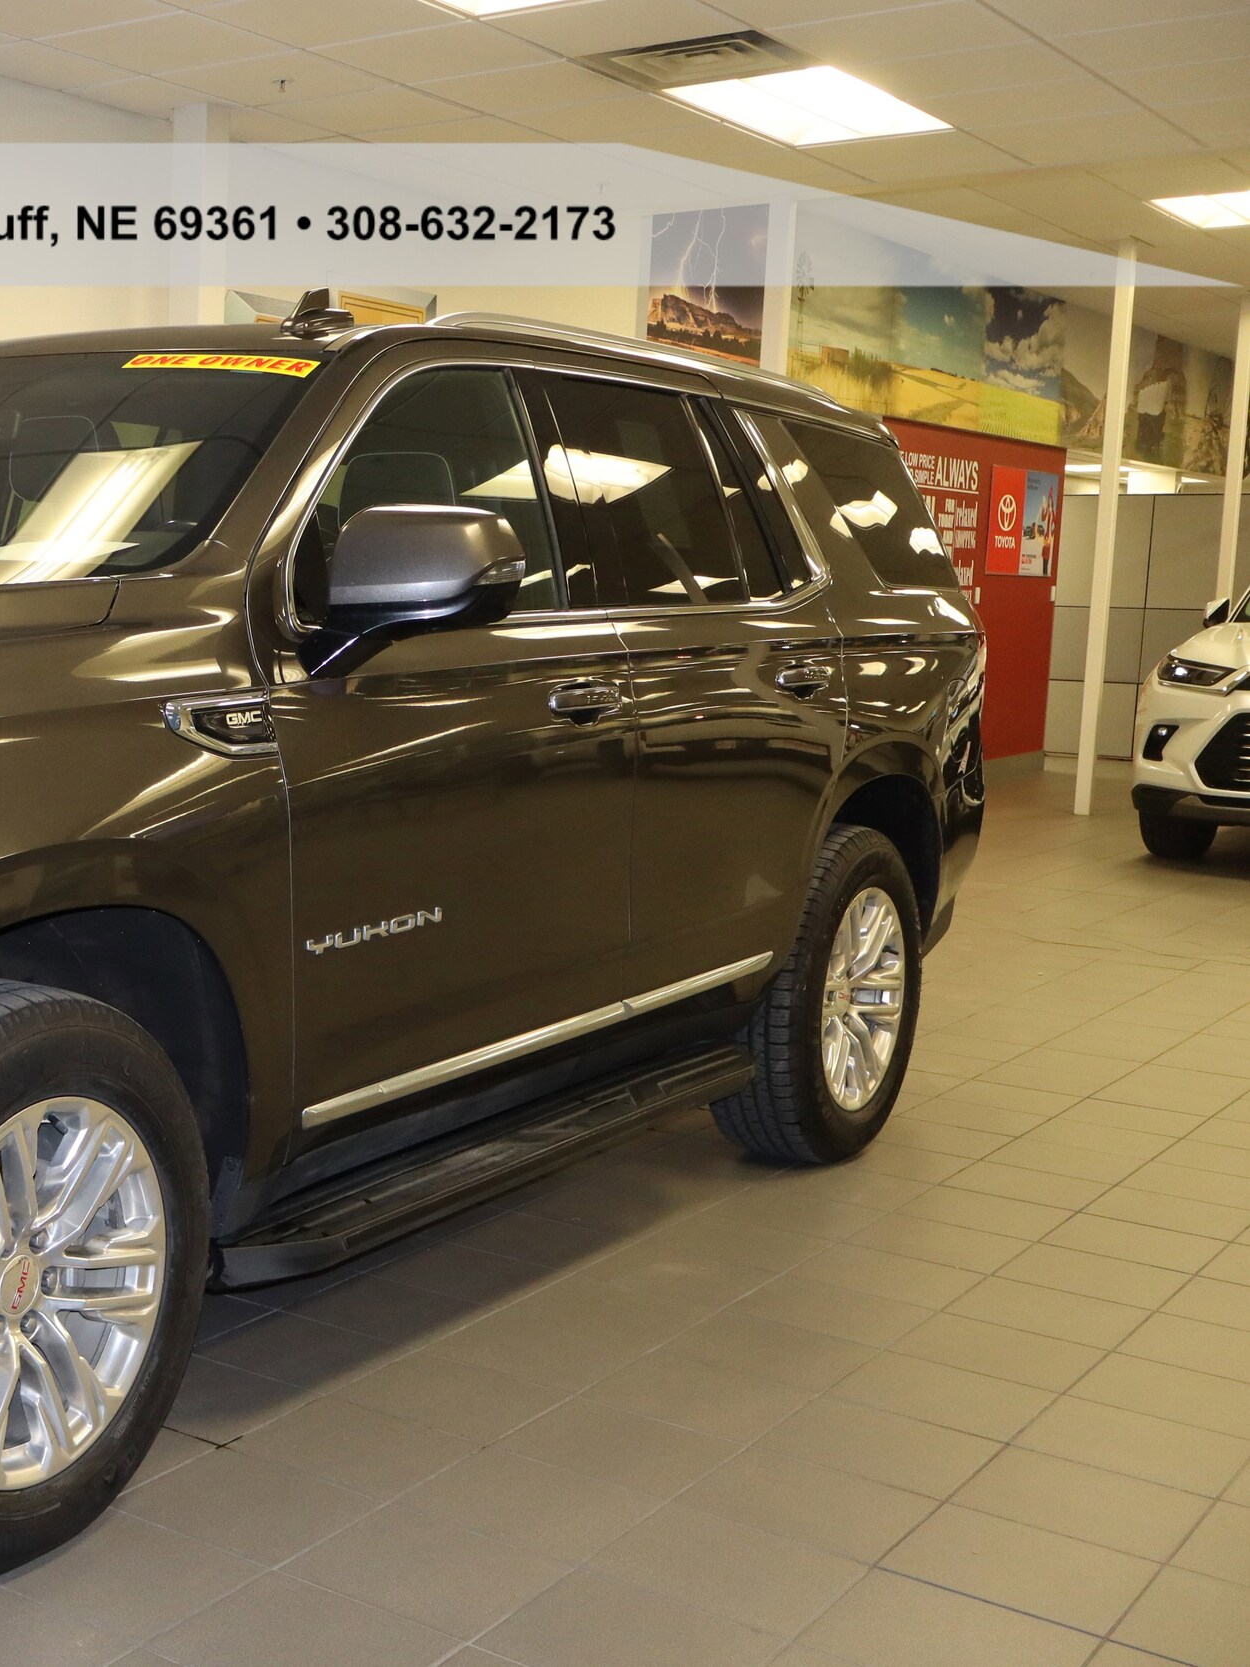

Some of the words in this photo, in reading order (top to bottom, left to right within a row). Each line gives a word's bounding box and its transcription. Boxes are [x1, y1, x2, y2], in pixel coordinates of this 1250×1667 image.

[130, 355, 191, 366] ONE
[199, 356, 312, 373] OWNER
[904, 451, 918, 466] LOW
[918, 453, 936, 469] PRICE
[934, 456, 979, 491] ALWAYS
[994, 535, 1016, 549] TOYOTA
[226, 710, 262, 725] GMC
[306, 906, 443, 955] YUKON
[11, 1260, 30, 1310] GMC
